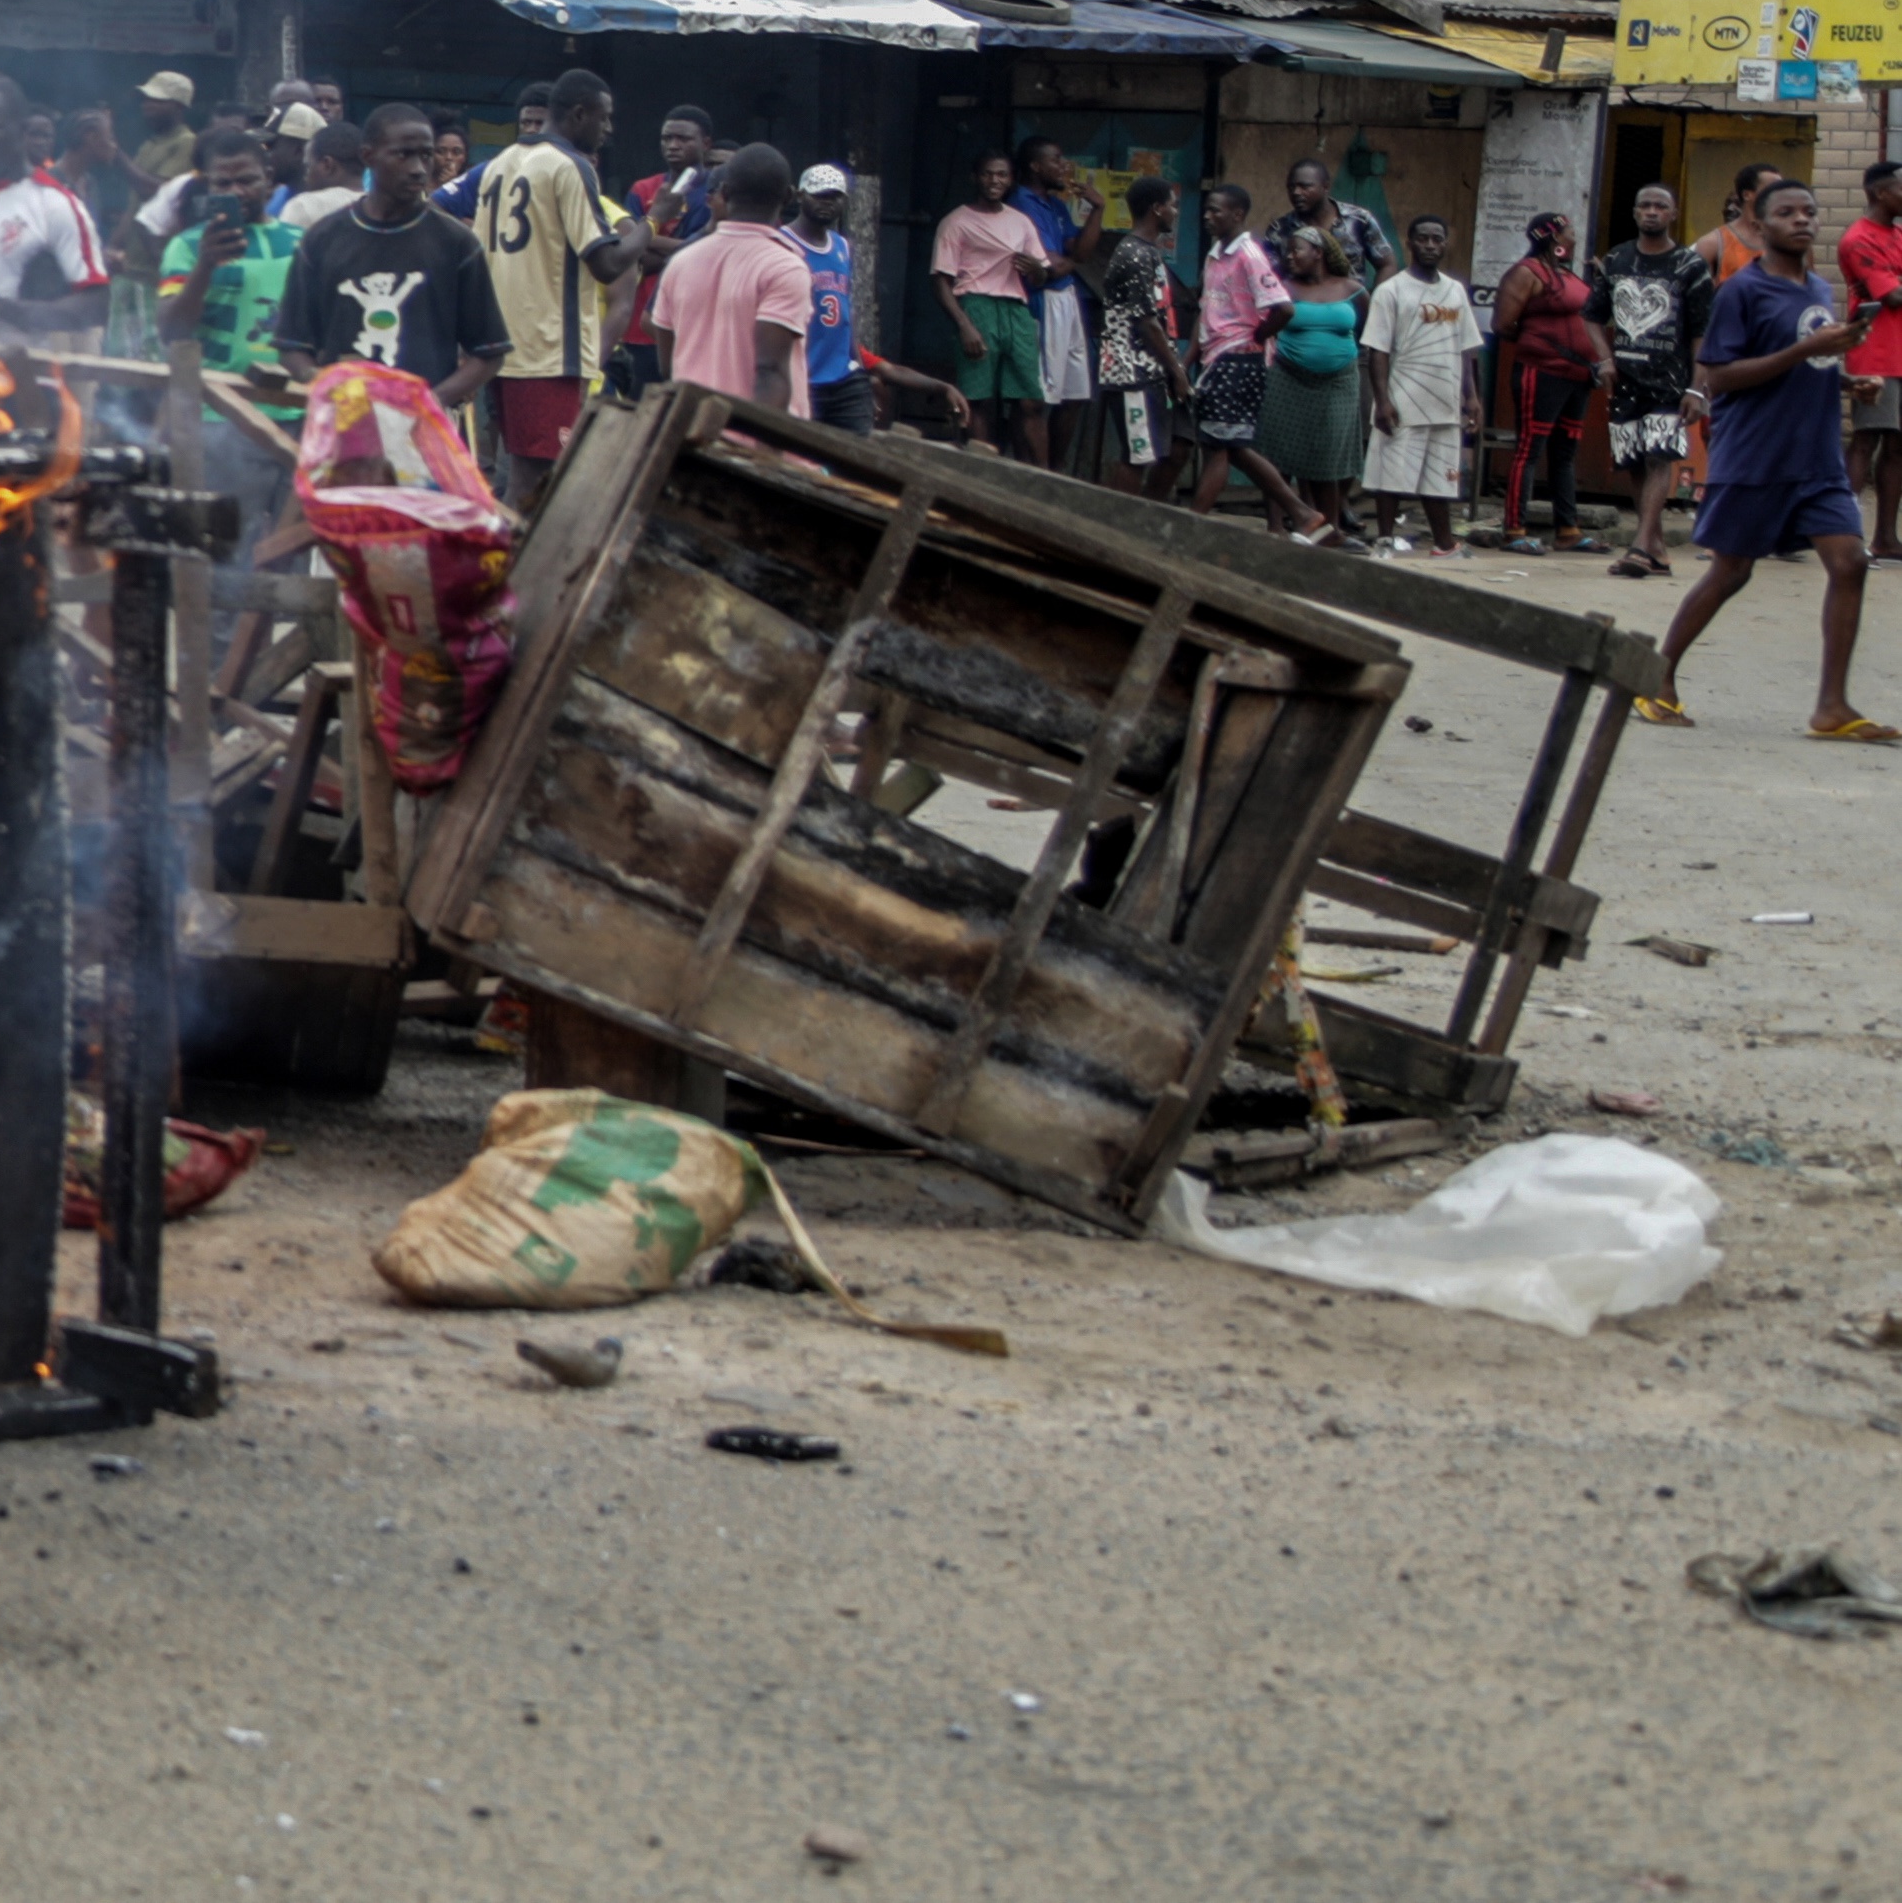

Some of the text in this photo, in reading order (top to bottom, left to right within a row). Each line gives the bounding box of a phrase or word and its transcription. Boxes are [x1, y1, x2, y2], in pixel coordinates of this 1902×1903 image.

[1652, 26, 1681, 37] MoMo
[1714, 27, 1740, 40] MTN
[1831, 24, 1883, 42] FEUZEU
[1542, 111, 1584, 124] Money
[482, 174, 532, 254] 13
[820, 294, 840, 327] 3
[1129, 407, 1144, 424] P
[1131, 437, 1147, 455] P
